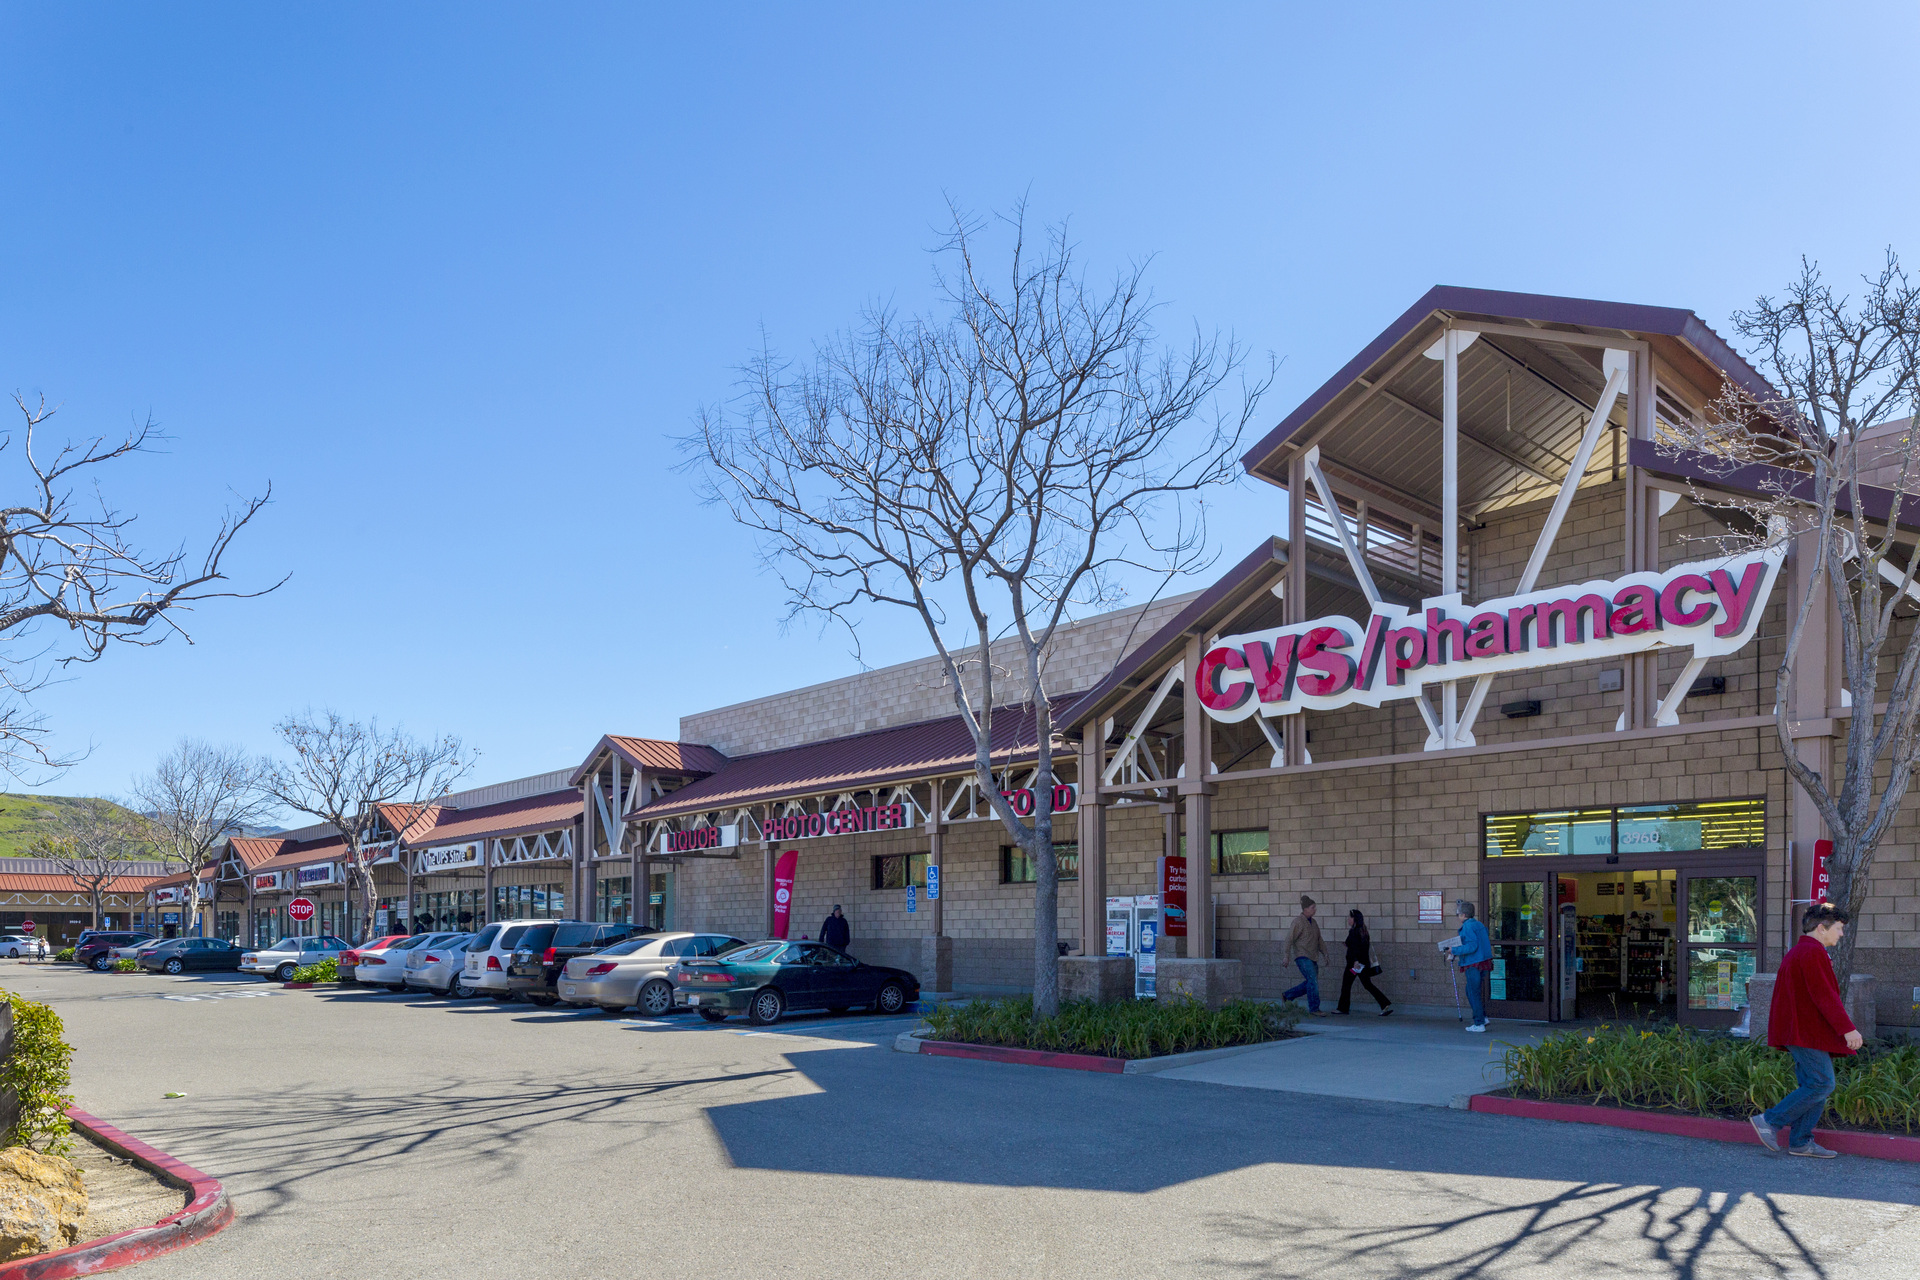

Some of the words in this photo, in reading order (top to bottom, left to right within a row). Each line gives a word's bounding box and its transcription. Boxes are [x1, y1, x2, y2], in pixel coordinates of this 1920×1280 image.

[1195, 562, 1767, 710] CVS/pharmacy
[1000, 785, 1071, 816] OD
[763, 813, 821, 841] PHOTO
[826, 803, 902, 834] CENTER
[667, 826, 718, 852] LIQUOR
[1623, 830, 1659, 844] 3960
[425, 854, 436, 866] The
[437, 851, 448, 864] UPS
[450, 850, 466, 863] Store
[1057, 855, 1078, 871] TM
[1169, 865, 1179, 875] Try
[256, 875, 275, 888] NAILS
[291, 905, 313, 914] STOP
